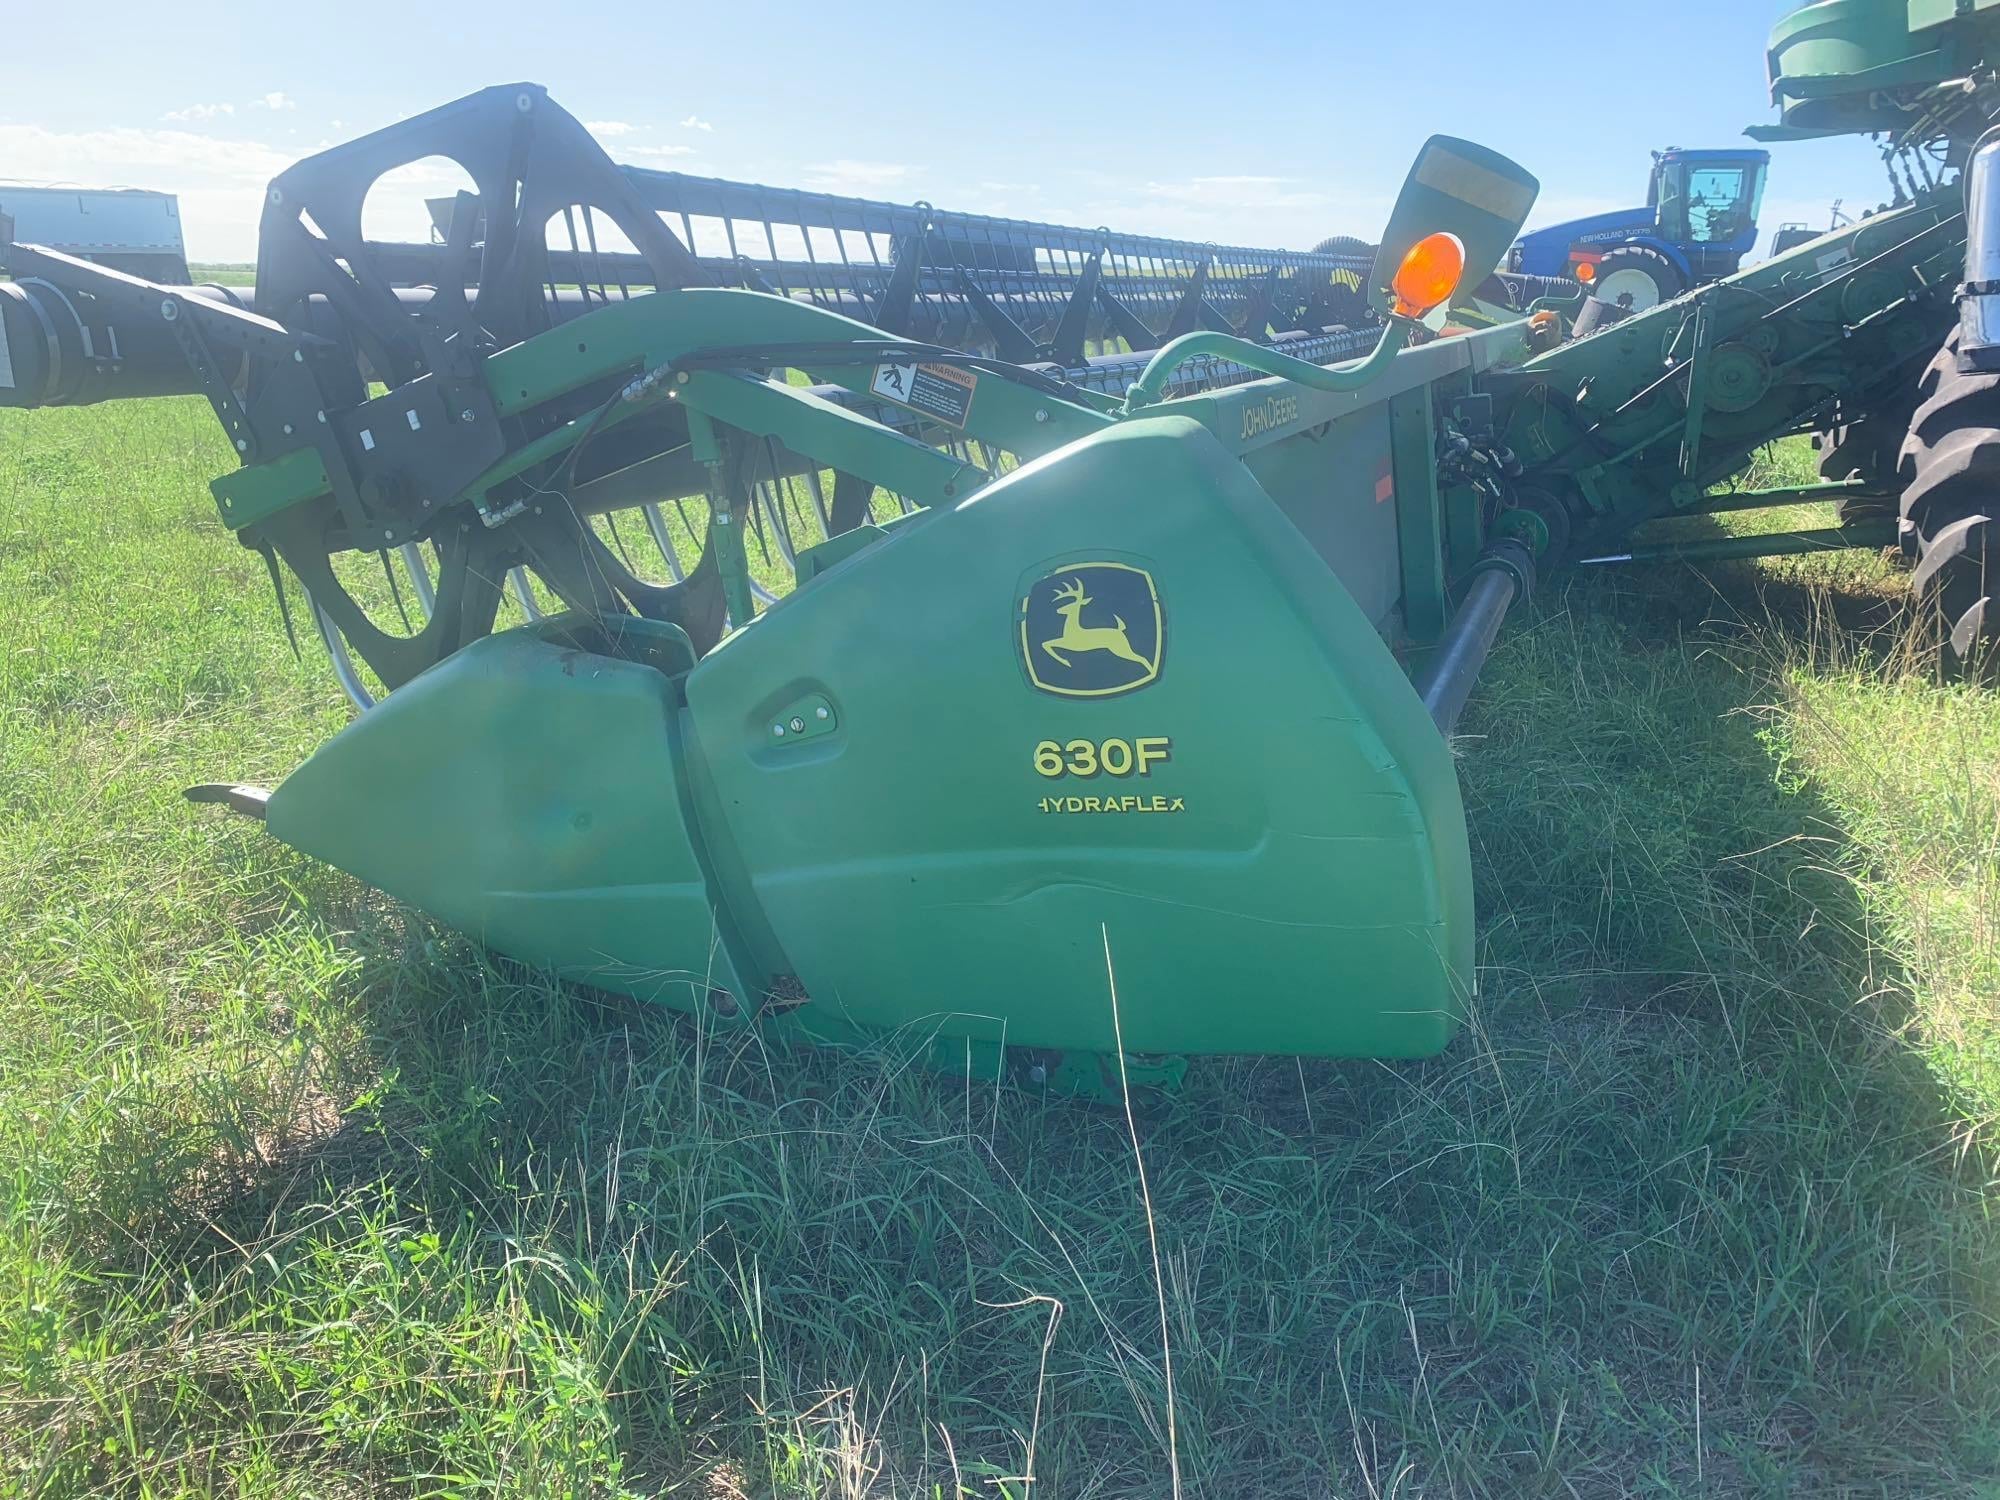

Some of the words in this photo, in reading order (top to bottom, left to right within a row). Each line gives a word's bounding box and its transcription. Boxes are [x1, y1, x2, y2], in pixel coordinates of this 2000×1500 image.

[1580, 234, 1594, 243] NEW
[1595, 230, 1624, 240] HOLLAND
[931, 362, 971, 385] WARNING
[1240, 404, 1269, 440] JOHN
[1267, 395, 1299, 429] DEERE
[1033, 736, 1170, 777] 630F
